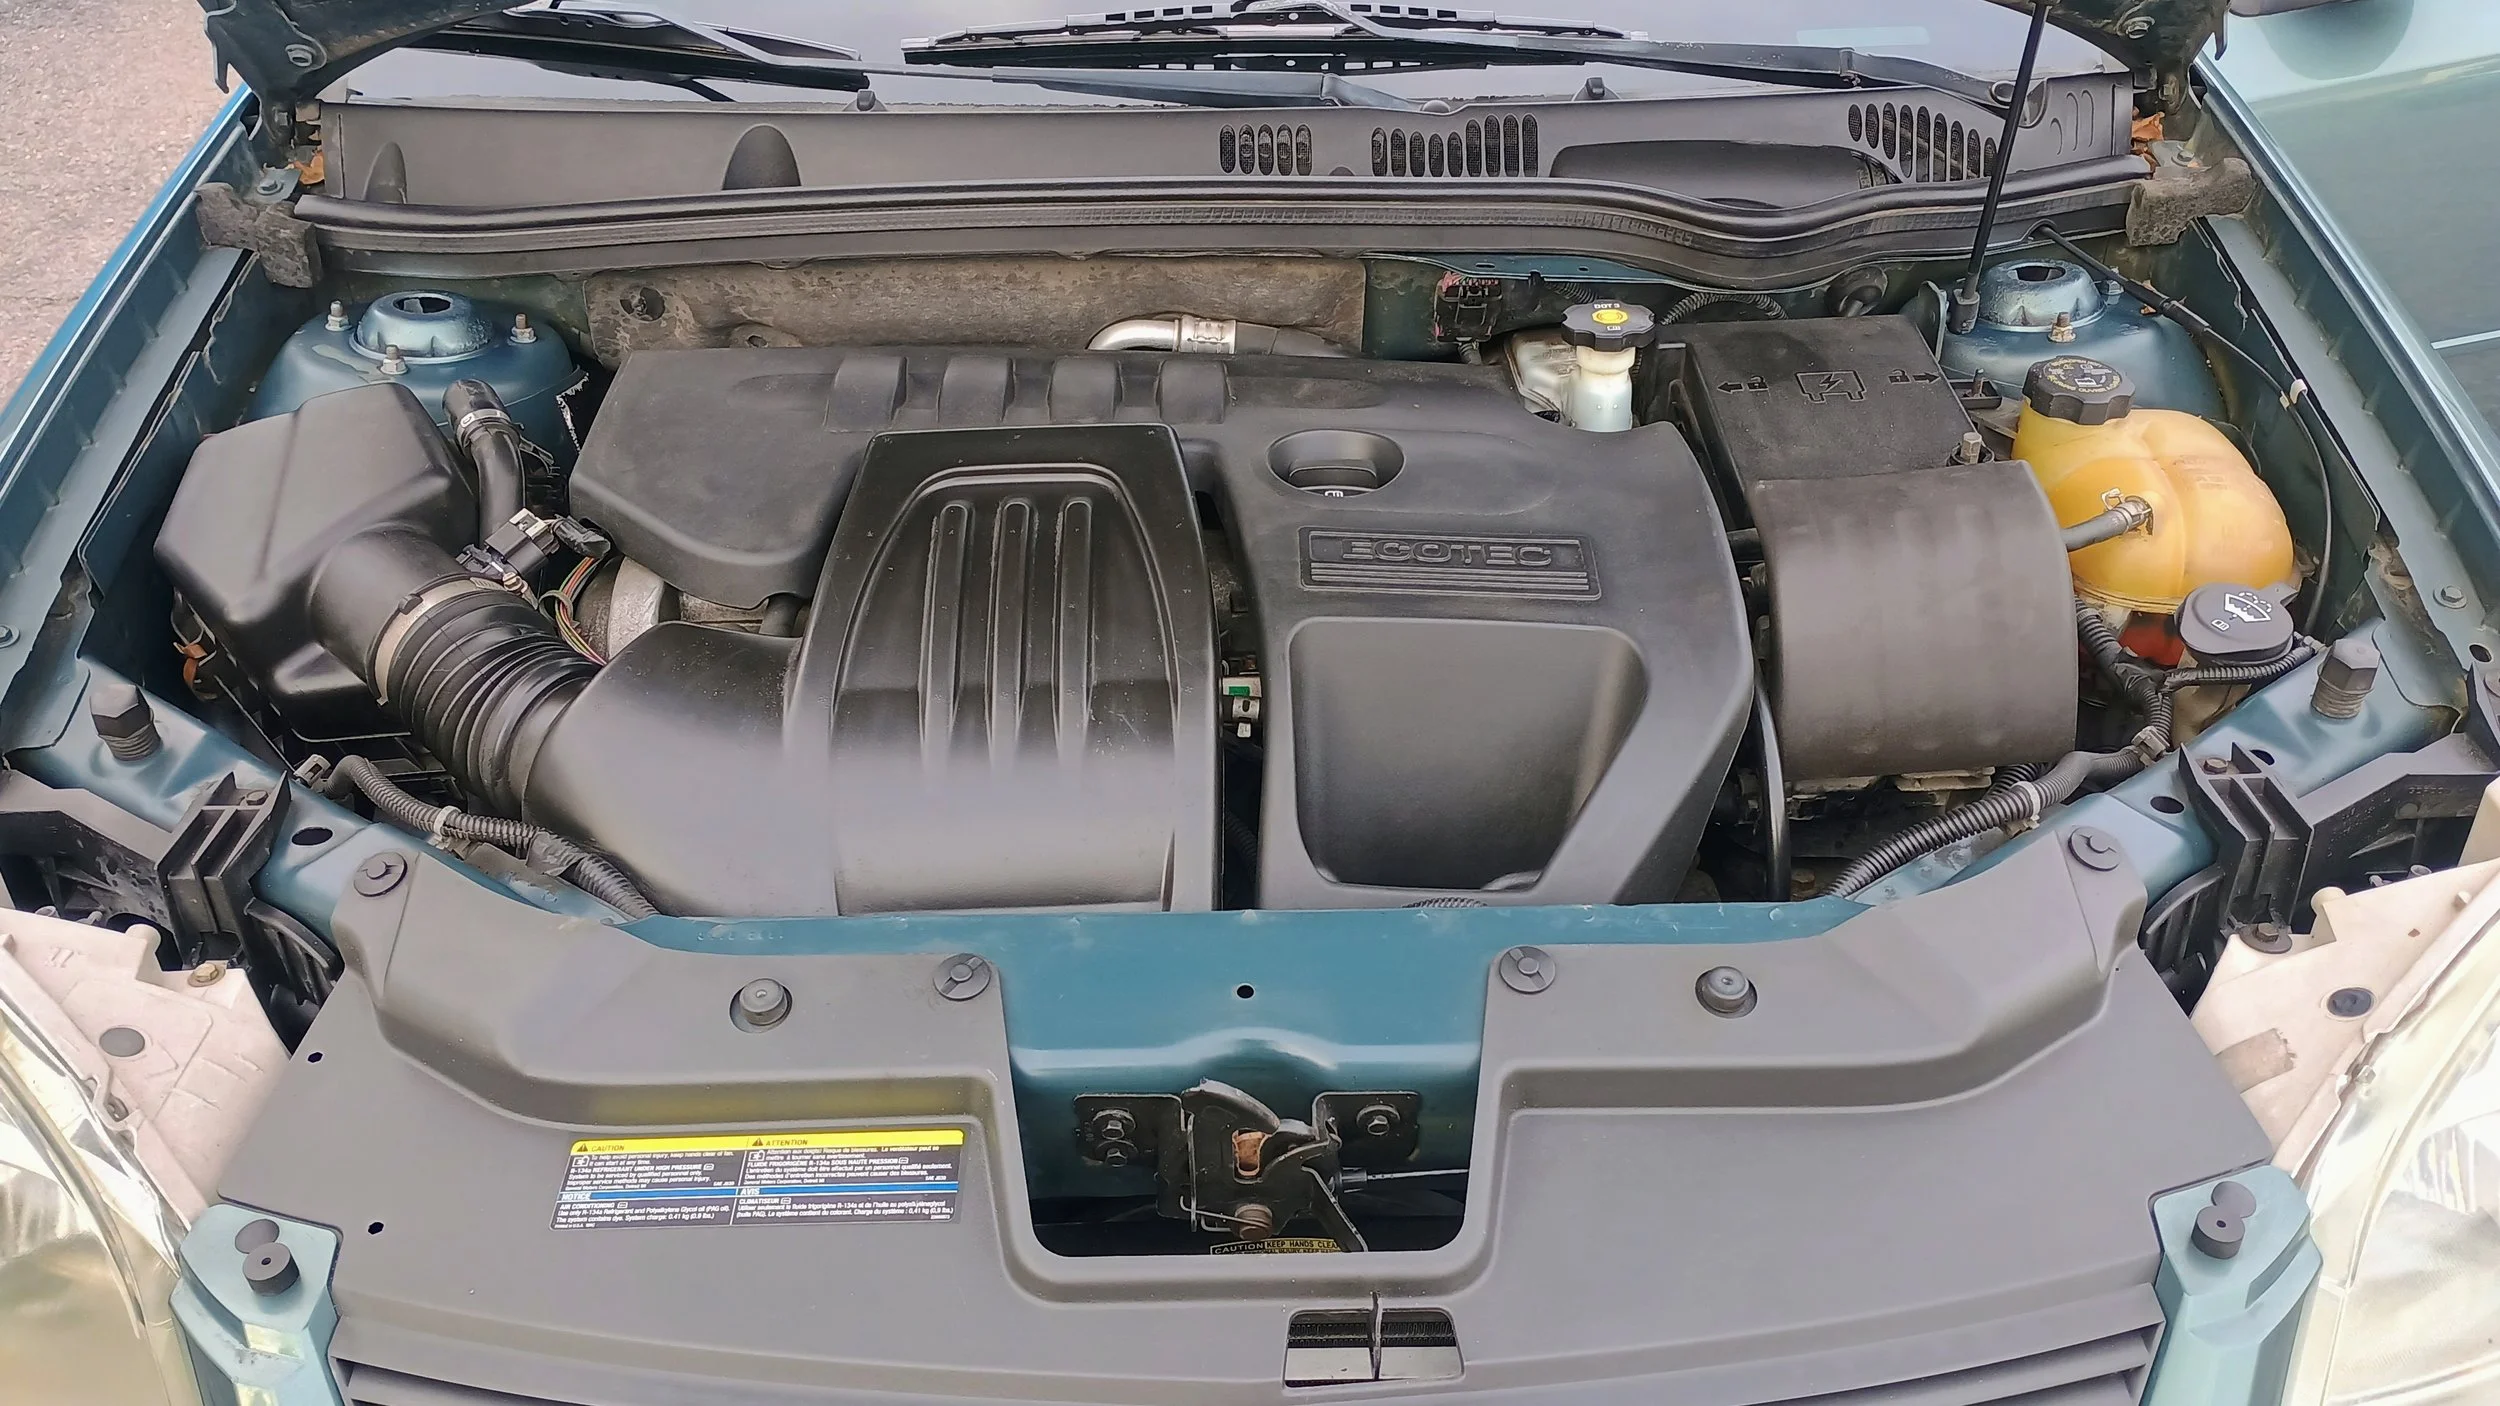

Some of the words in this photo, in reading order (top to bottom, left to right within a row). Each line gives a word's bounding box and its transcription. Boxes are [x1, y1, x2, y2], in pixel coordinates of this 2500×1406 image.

[1342, 538, 1552, 567] ECOTEC
[591, 1144, 625, 1152] CAUTION
[561, 1192, 592, 1201] NOTICE
[1214, 1242, 1264, 1254] CAUTION
